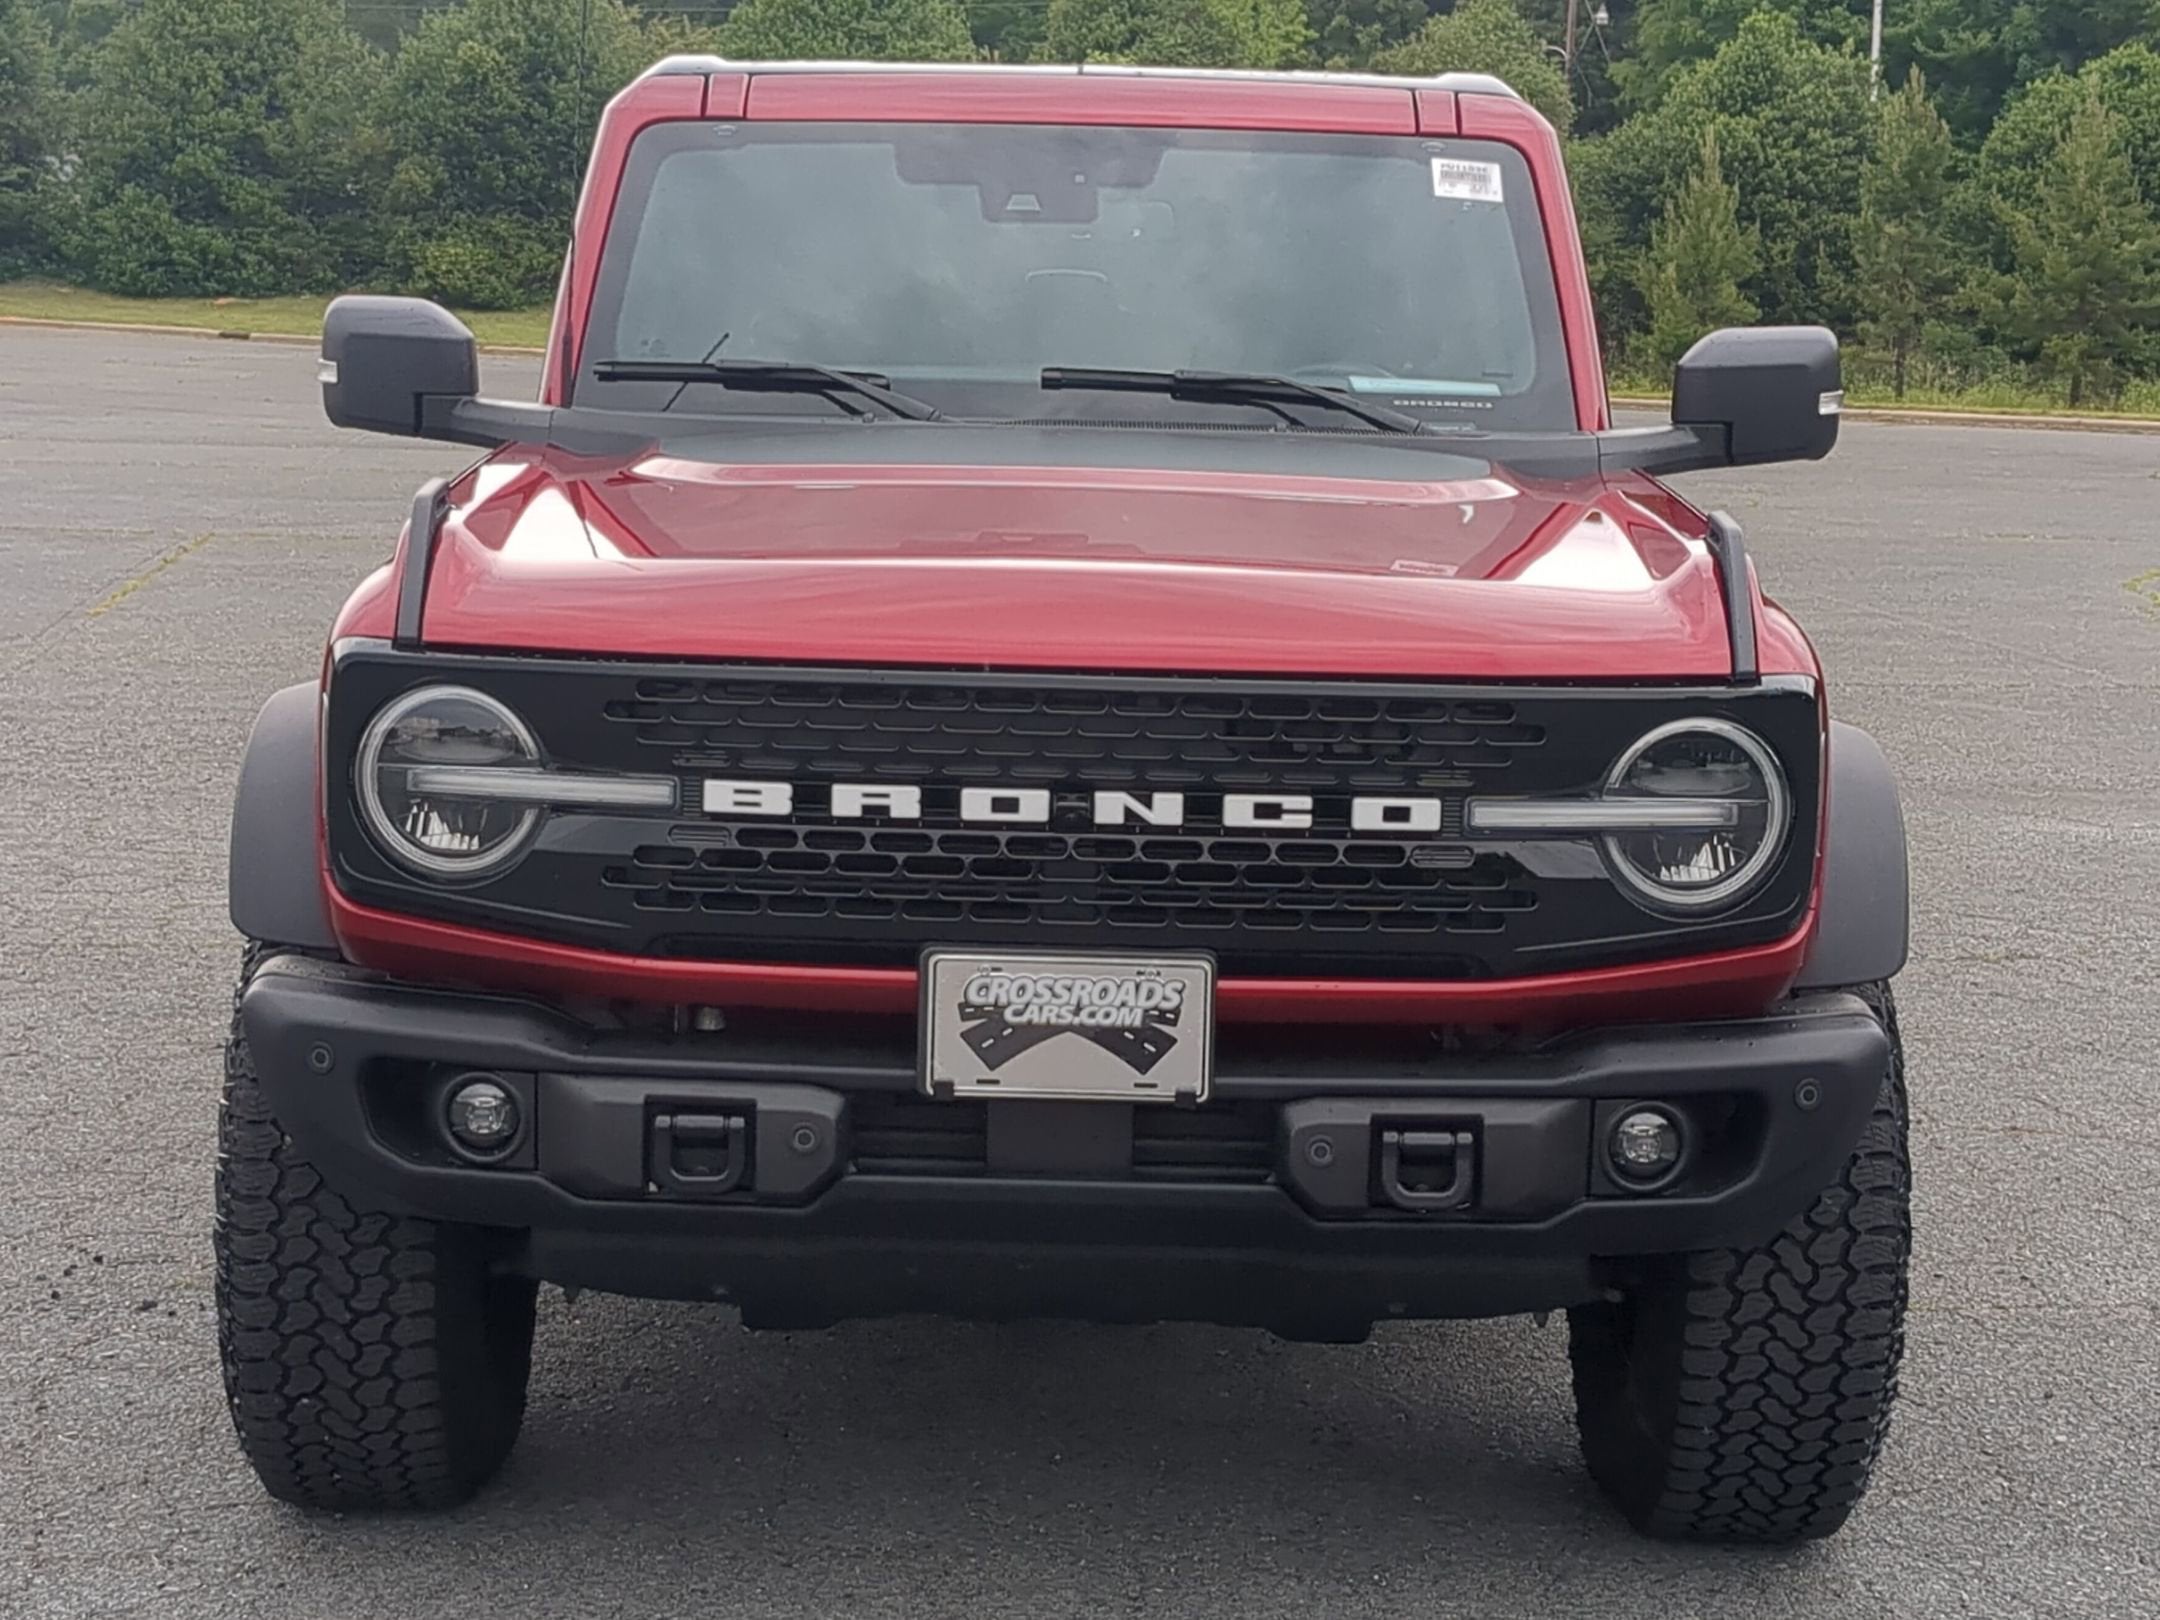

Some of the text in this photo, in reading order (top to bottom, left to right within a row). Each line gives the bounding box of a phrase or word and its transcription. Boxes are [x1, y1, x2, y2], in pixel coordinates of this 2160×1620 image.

[703, 778, 1441, 832] BRONCO
[965, 974, 1185, 1010] CROSSROADS
[1003, 1004, 1143, 1027] CARS.COM
